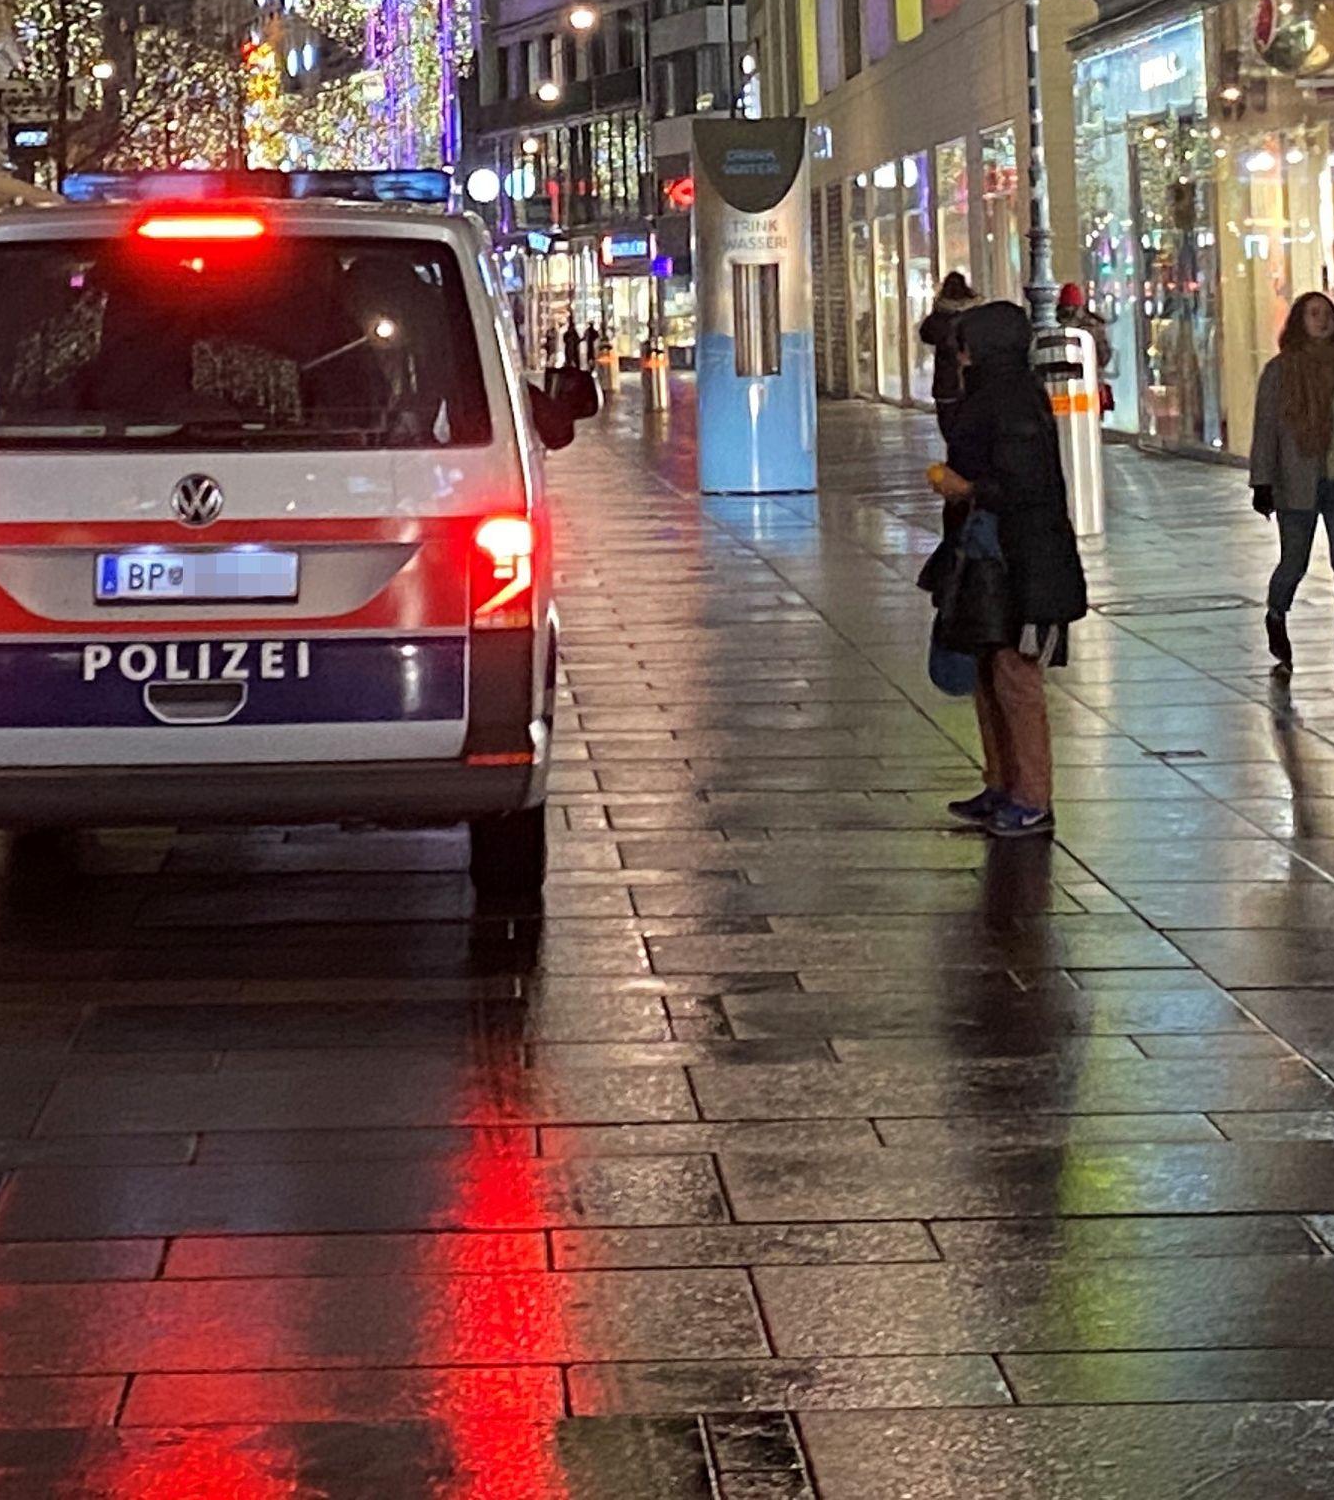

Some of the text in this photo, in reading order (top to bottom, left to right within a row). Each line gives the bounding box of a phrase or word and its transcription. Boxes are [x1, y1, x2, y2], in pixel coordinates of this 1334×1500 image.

[732, 219, 778, 233] TRINK
[128, 562, 165, 591] BP
[82, 641, 310, 682] POLIZEI
